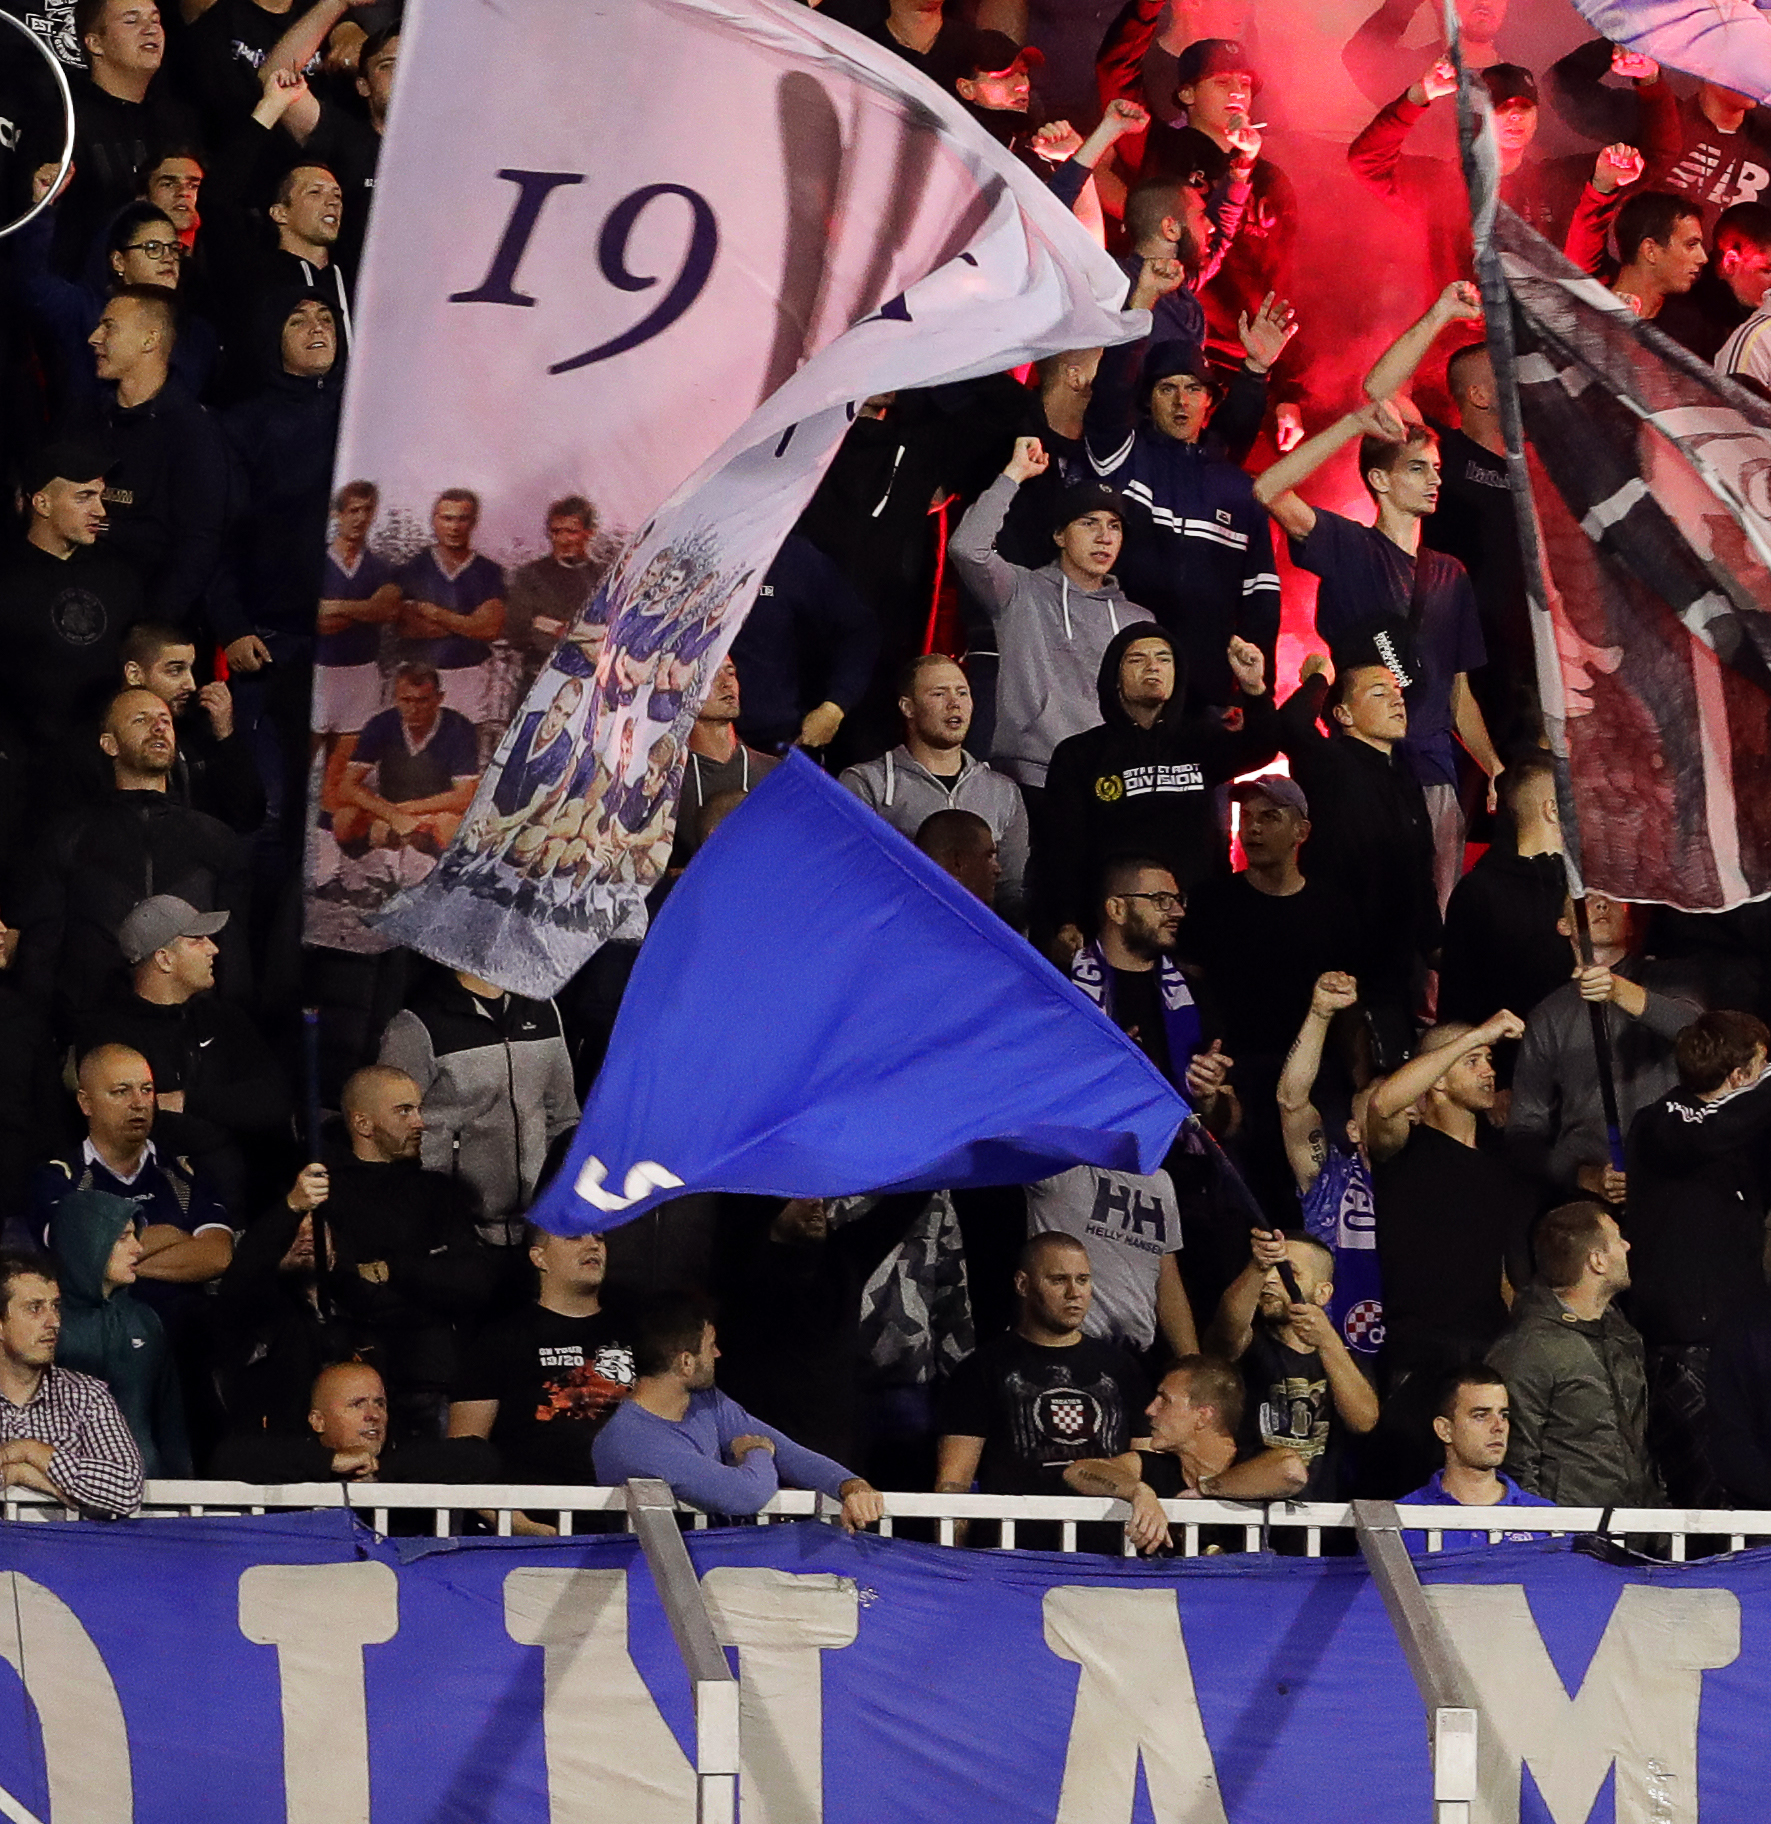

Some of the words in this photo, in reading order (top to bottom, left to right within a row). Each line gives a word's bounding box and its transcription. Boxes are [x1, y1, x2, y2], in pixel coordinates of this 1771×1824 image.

[31, 19, 58, 35] EST.
[1124, 771, 1204, 791] DIVISION
[1089, 1176, 1167, 1243] HH
[1085, 1223, 1122, 1243] HELLY
[1123, 1232, 1166, 1257] HANSEN
[538, 1347, 553, 1357] ON
[554, 1345, 583, 1356] TOUR
[539, 1355, 585, 1367] 19/20
